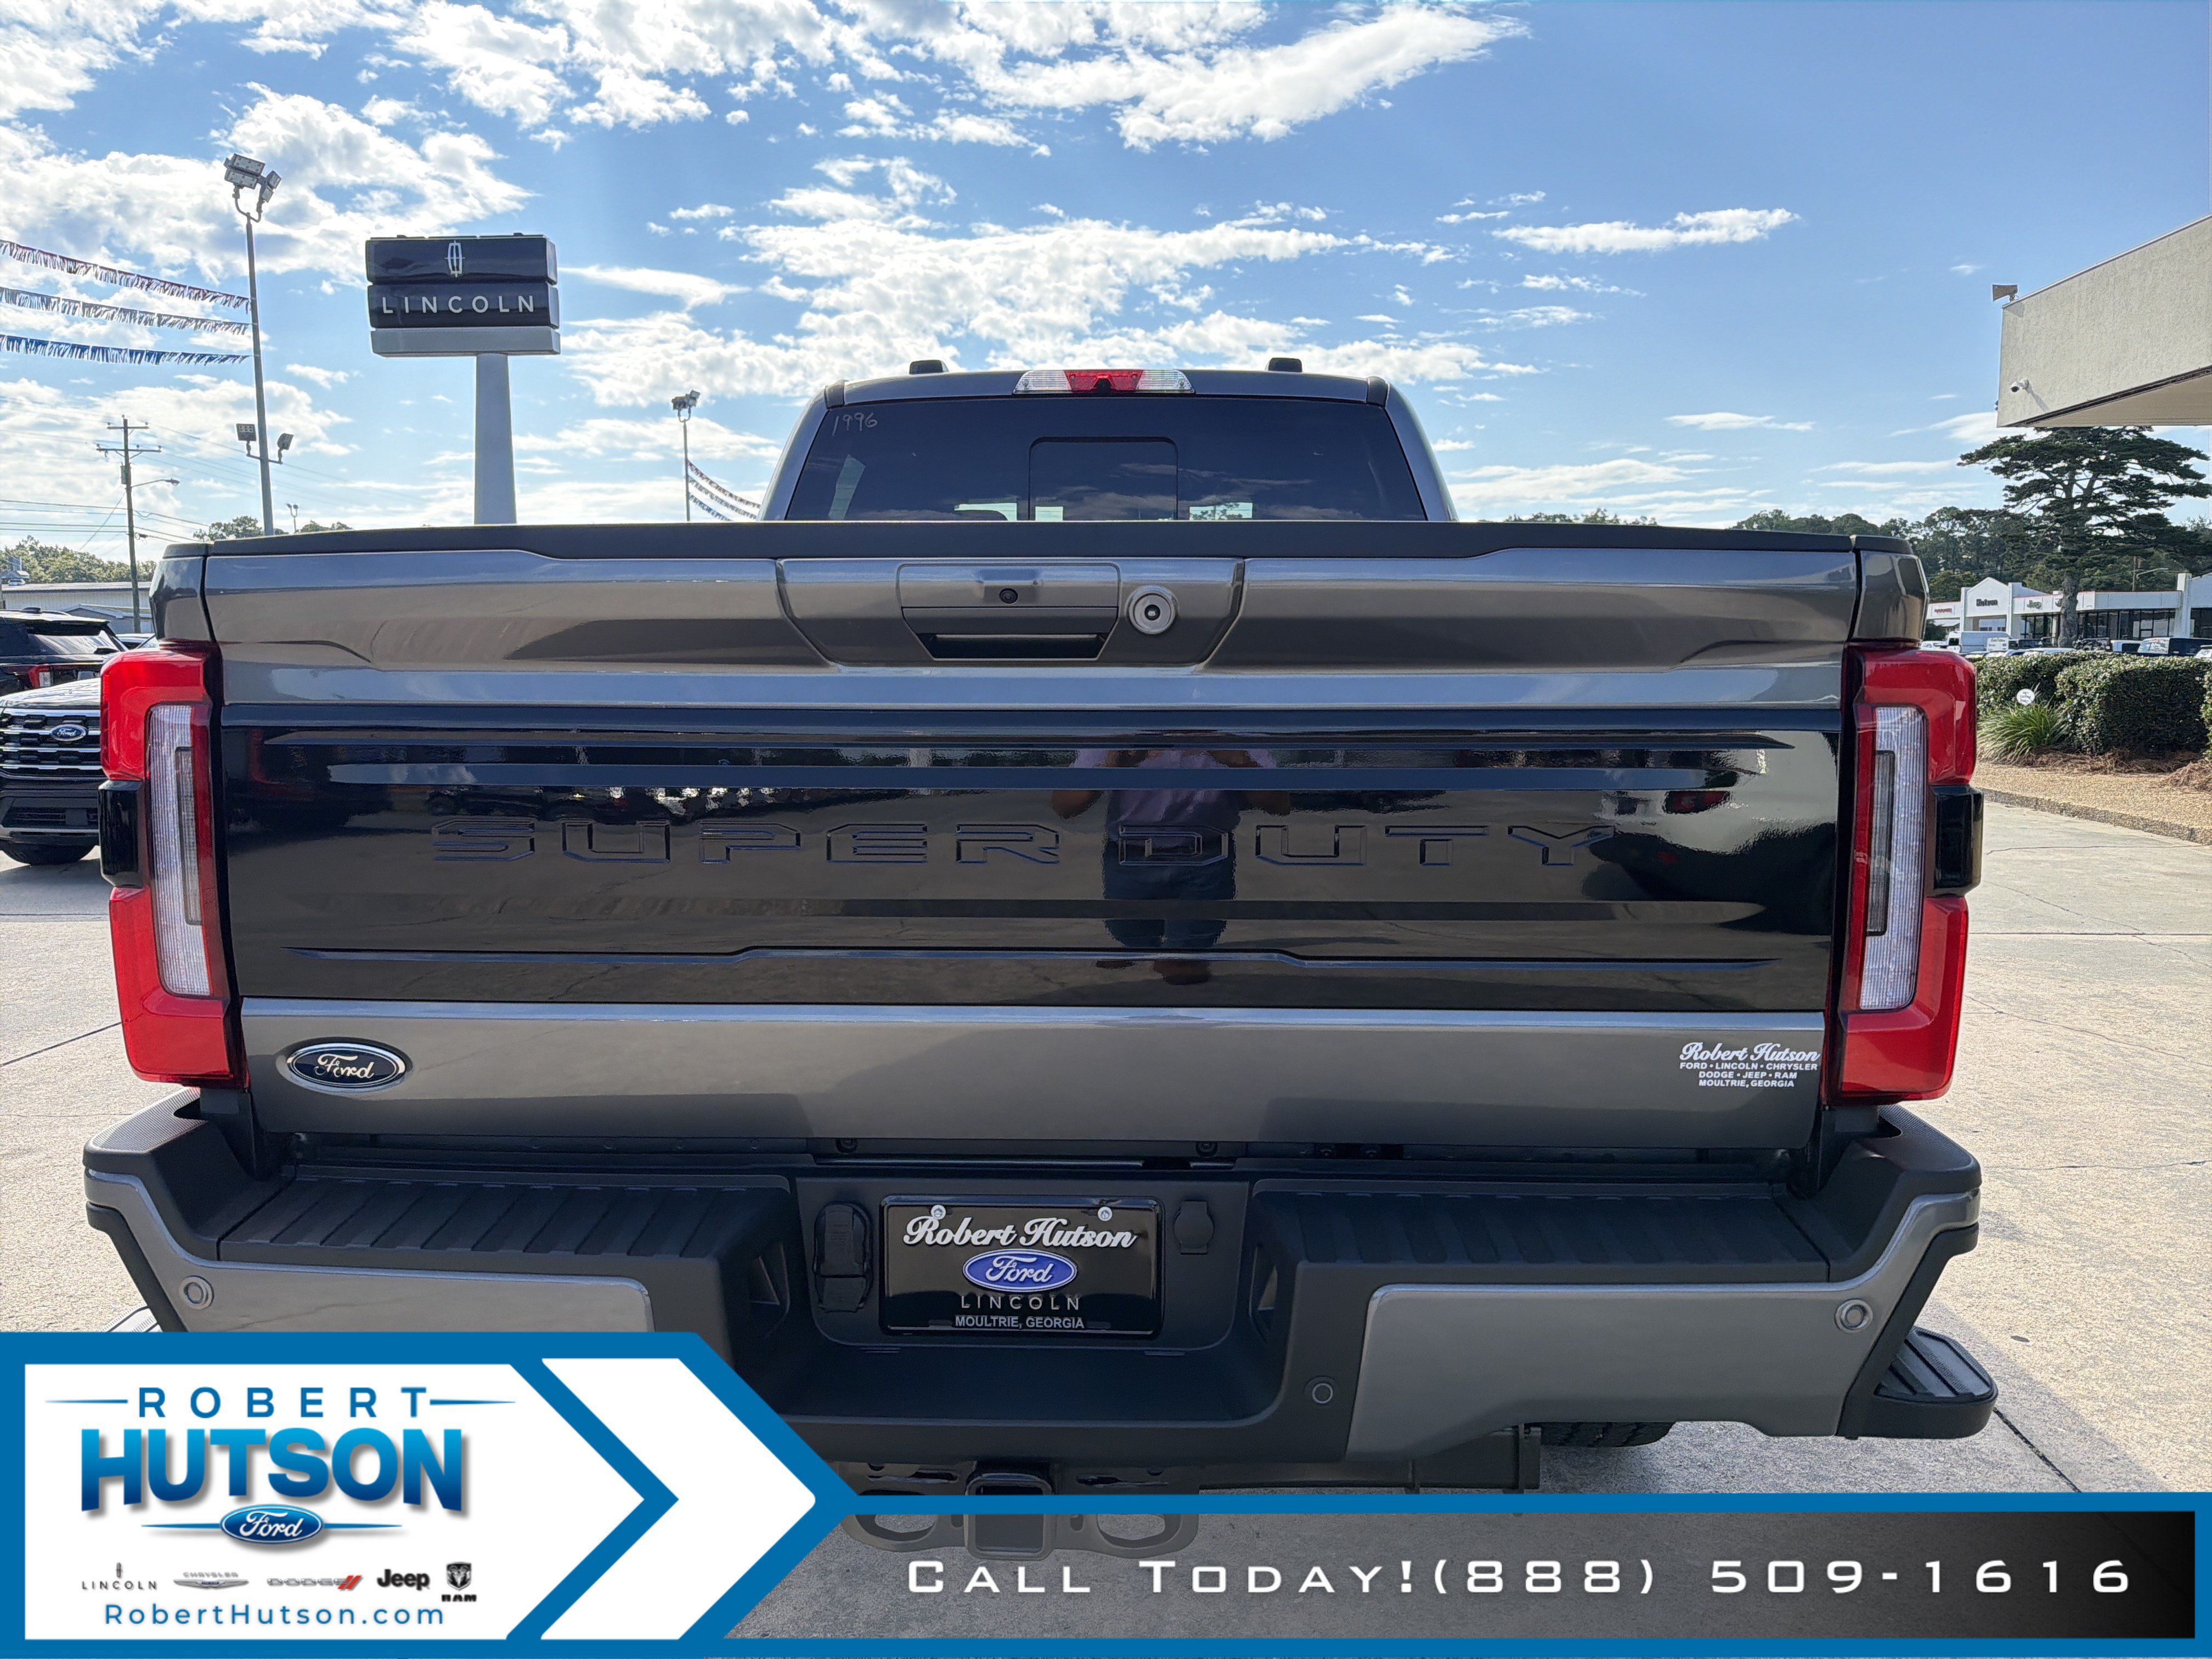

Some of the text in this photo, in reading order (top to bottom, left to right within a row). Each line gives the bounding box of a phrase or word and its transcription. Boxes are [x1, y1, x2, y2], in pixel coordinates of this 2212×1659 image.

[382, 295, 534, 313] LINCOLN
[832, 413, 878, 437] 1996
[57, 727, 77, 738] Ford
[432, 817, 1615, 866] SUPER DUTY
[1679, 1042, 1821, 1062] Robert Hutson
[314, 1053, 375, 1078] Ford
[1766, 1063, 1818, 1071] CHRYSLER
[1699, 1080, 1749, 1088] MOULTRIE,
[902, 1215, 1138, 1249] Robert Hutson
[986, 1256, 1053, 1284] Ford
[961, 1296, 1080, 1311] LINCOLN
[955, 1316, 1085, 1329] MOULTRIE, GEORGIA
